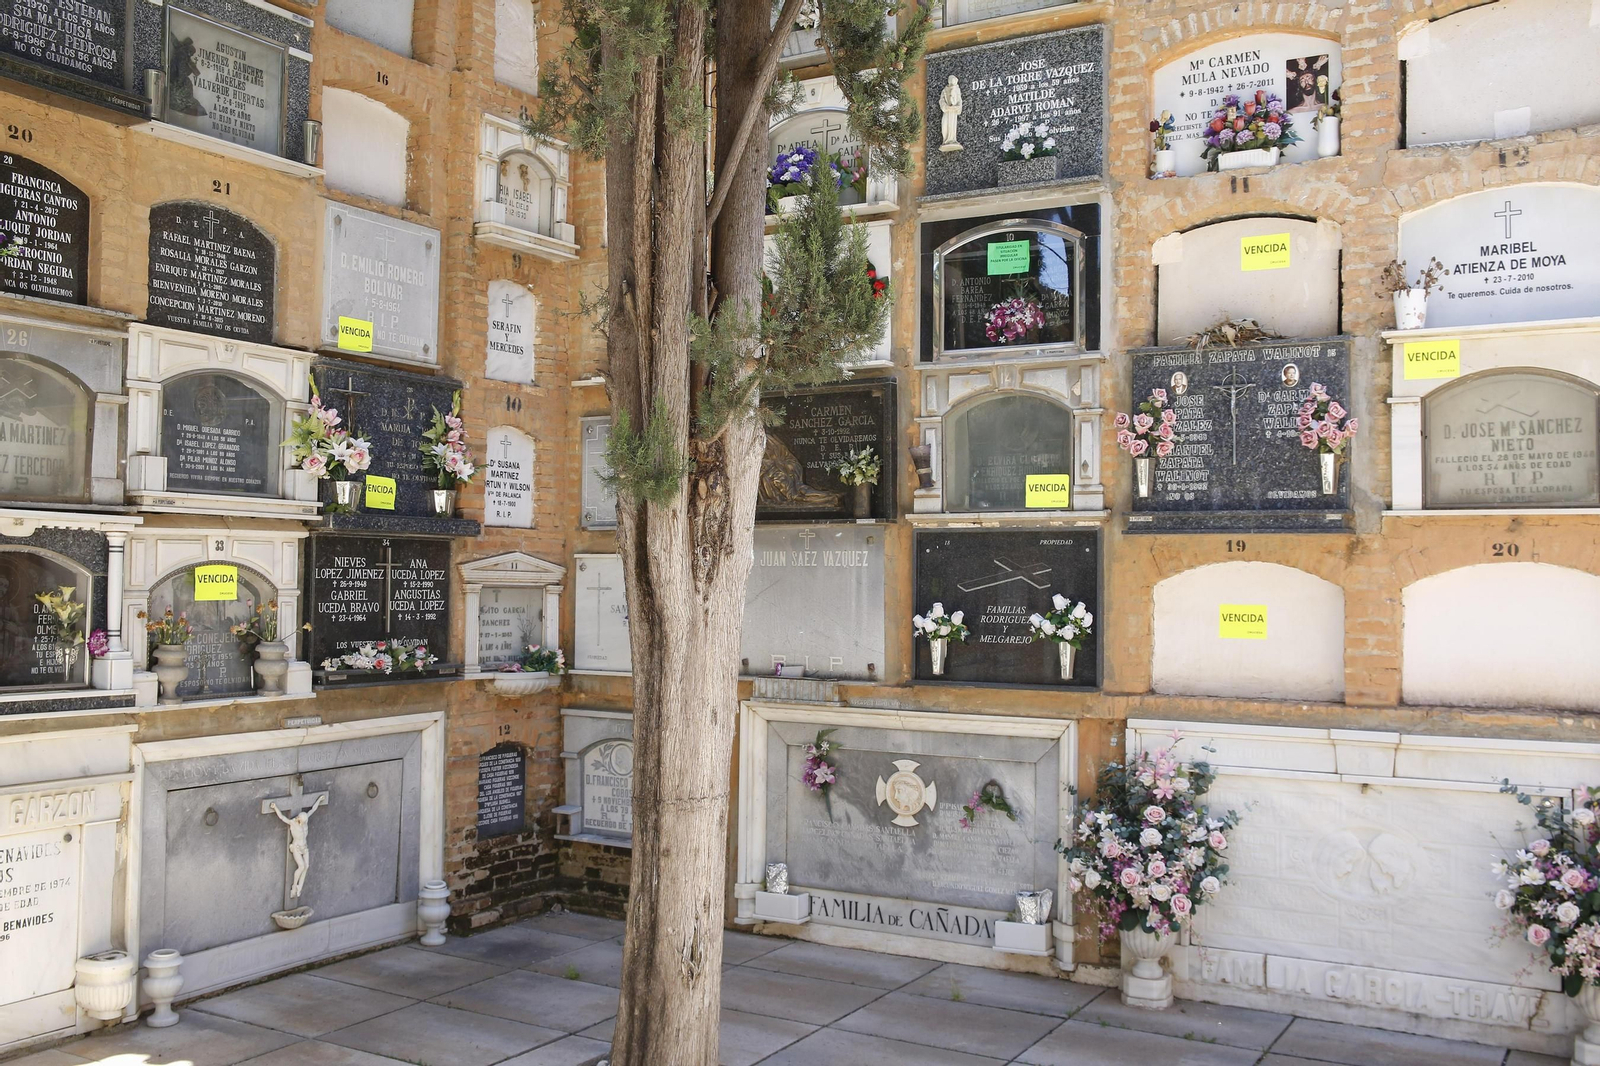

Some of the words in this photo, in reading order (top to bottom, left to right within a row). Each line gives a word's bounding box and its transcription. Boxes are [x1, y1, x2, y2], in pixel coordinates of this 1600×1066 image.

[62, 11, 78, 23] LOS
[81, 18, 91, 28] 78
[58, 19, 92, 41] LUISA
[60, 46, 75, 57] LOS
[78, 52, 89, 62] 56
[65, 34, 117, 62] PEDROSA
[216, 42, 246, 61] AGUSTIN
[15, 41, 26, 51] NO
[31, 47, 42, 56] OS
[46, 52, 92, 72] OLVIDAMOS
[198, 48, 229, 67] JIMENEZ
[234, 61, 263, 79] SANCHEZ
[1190, 59, 1204, 71] Mª
[1209, 50, 1261, 68] CARMEN
[1019, 59, 1046, 72] JOSE
[377, 71, 389, 86] 16
[972, 80, 986, 91] DE
[990, 77, 1003, 88] LA
[1006, 71, 1042, 84] TORRE
[1046, 62, 1094, 78] VAZQUEZ
[1182, 70, 1217, 85] MULA
[1221, 62, 1270, 80] NEVADO
[216, 73, 246, 91] ANGELES
[1189, 86, 1224, 97] 9-8-1942
[1236, 79, 1274, 90] 26-7-2011
[193, 75, 229, 97] VALVERDE
[233, 90, 264, 108] HUERTAS
[1009, 88, 1055, 104] MATILDE
[990, 104, 1031, 118] ADARVE
[1036, 97, 1075, 111] ROMAN
[1185, 112, 1197, 121] NO
[8, 124, 33, 143] 20
[3, 155, 12, 164] 20
[12, 172, 62, 194] FRANCISCA
[212, 180, 230, 195] 21
[44, 194, 78, 211] CANTOS
[513, 189, 532, 204] ISABEL
[15, 210, 57, 227] ANTONIO
[36, 227, 72, 244] JORDAN
[163, 231, 191, 245] RAFAEL
[194, 238, 230, 253] MARTINEZ
[234, 247, 256, 260] BAENA
[1244, 243, 1287, 255] VENCIDA
[1480, 242, 1537, 257] MARIBEL
[160, 247, 191, 261] ROSALIA
[195, 255, 227, 269] MORALES
[230, 263, 258, 275] GARZON
[1454, 260, 1505, 275] ATIENZA
[1511, 258, 1526, 270] DE
[1532, 254, 1566, 268] MOYA
[38, 263, 73, 279] SEGURA
[155, 263, 188, 277] ENRIQUE
[190, 270, 227, 285] MARTINEZ
[230, 278, 262, 292] MORALES
[352, 255, 384, 278] EMILIO
[388, 263, 423, 287] ROMERO
[364, 277, 403, 300] BOLIVAR
[960, 277, 991, 286] ANTONIO
[31, 283, 73, 298] OLVIDAREMOS
[153, 279, 197, 295] BIENVENIDA
[200, 288, 229, 301] MORENO
[232, 294, 263, 308] MORALES
[961, 286, 983, 294] BAREA
[1458, 289, 1498, 300] queremos.
[1500, 286, 1521, 295] Cuida
[1524, 285, 1533, 293] de
[1536, 283, 1573, 293] nosotros.
[952, 294, 992, 303] FERNANDEZ
[150, 296, 195, 311] CONCEPCION
[198, 304, 235, 318] MARTINEZ
[237, 311, 265, 324] MORENO
[341, 325, 370, 338] VENCIDA
[492, 320, 521, 333] SERAFIN
[7, 329, 28, 347] 26
[505, 333, 509, 342] Y
[489, 341, 524, 355] MERCEDES
[1153, 355, 1203, 367] FAMILIA
[1209, 350, 1255, 362] ZAPATA
[1263, 346, 1320, 360] WALINOT
[1408, 351, 1456, 362] VENCIDA
[506, 395, 522, 412] 10
[1175, 395, 1204, 406] JOSE
[811, 405, 852, 417] CARMEN
[790, 417, 833, 429] SANCHEZ
[838, 415, 874, 426] GARCIA
[1462, 423, 1495, 439] JOSE
[1519, 418, 1582, 436] SANCHEZ
[10, 422, 66, 446] MARTINEZ
[830, 435, 876, 443] OLVIDAREMOS
[1491, 439, 1534, 452] NIETO
[498, 460, 520, 469] SUSANA
[1160, 458, 1204, 468] ZAPATA
[1435, 456, 1478, 464] FALLECIO
[1513, 453, 1524, 461] DE
[1529, 452, 1552, 460] MAYO
[1557, 451, 1569, 459] DE
[491, 470, 519, 480] MARTINEZ
[1155, 470, 1209, 482] WALINOT
[1029, 484, 1066, 492] VENCIDA
[1475, 487, 1511, 495] ESPOSA
[215, 541, 224, 551] 33
[1225, 540, 1246, 553] 19
[1492, 543, 1520, 557] 20
[335, 557, 366, 567] NIEVES
[410, 559, 427, 568] ANA
[761, 551, 786, 567] JUAN
[792, 551, 817, 566] SAEZ
[823, 551, 868, 568] VAZQUEZ
[198, 574, 234, 583] VENCIDA
[316, 568, 342, 578] LOPEZ
[346, 569, 384, 579] JIMENEZ
[392, 570, 417, 579] UCEDA
[421, 571, 445, 580] LOPEZ
[331, 590, 368, 600] GABRIEL
[394, 590, 440, 599] ANGUSTIAS
[319, 602, 346, 613] UCEDA
[351, 603, 379, 612] BRAVO
[390, 601, 415, 610] UCEDA
[420, 601, 444, 610] LOPEZ
[987, 606, 1026, 614] FAMILIAS
[980, 615, 1031, 624] RODRIGUEZ
[1222, 613, 1264, 623] VENCIDA
[1003, 625, 1008, 633] Y
[980, 635, 1032, 644] MELGAREJO
[498, 724, 510, 736] 12
[10, 789, 95, 826] GARZON
[3, 913, 54, 931] BENAVIDES
[809, 895, 884, 924] FAMILIA
[888, 915, 903, 926] DE
[909, 907, 995, 938] CAÑADA
